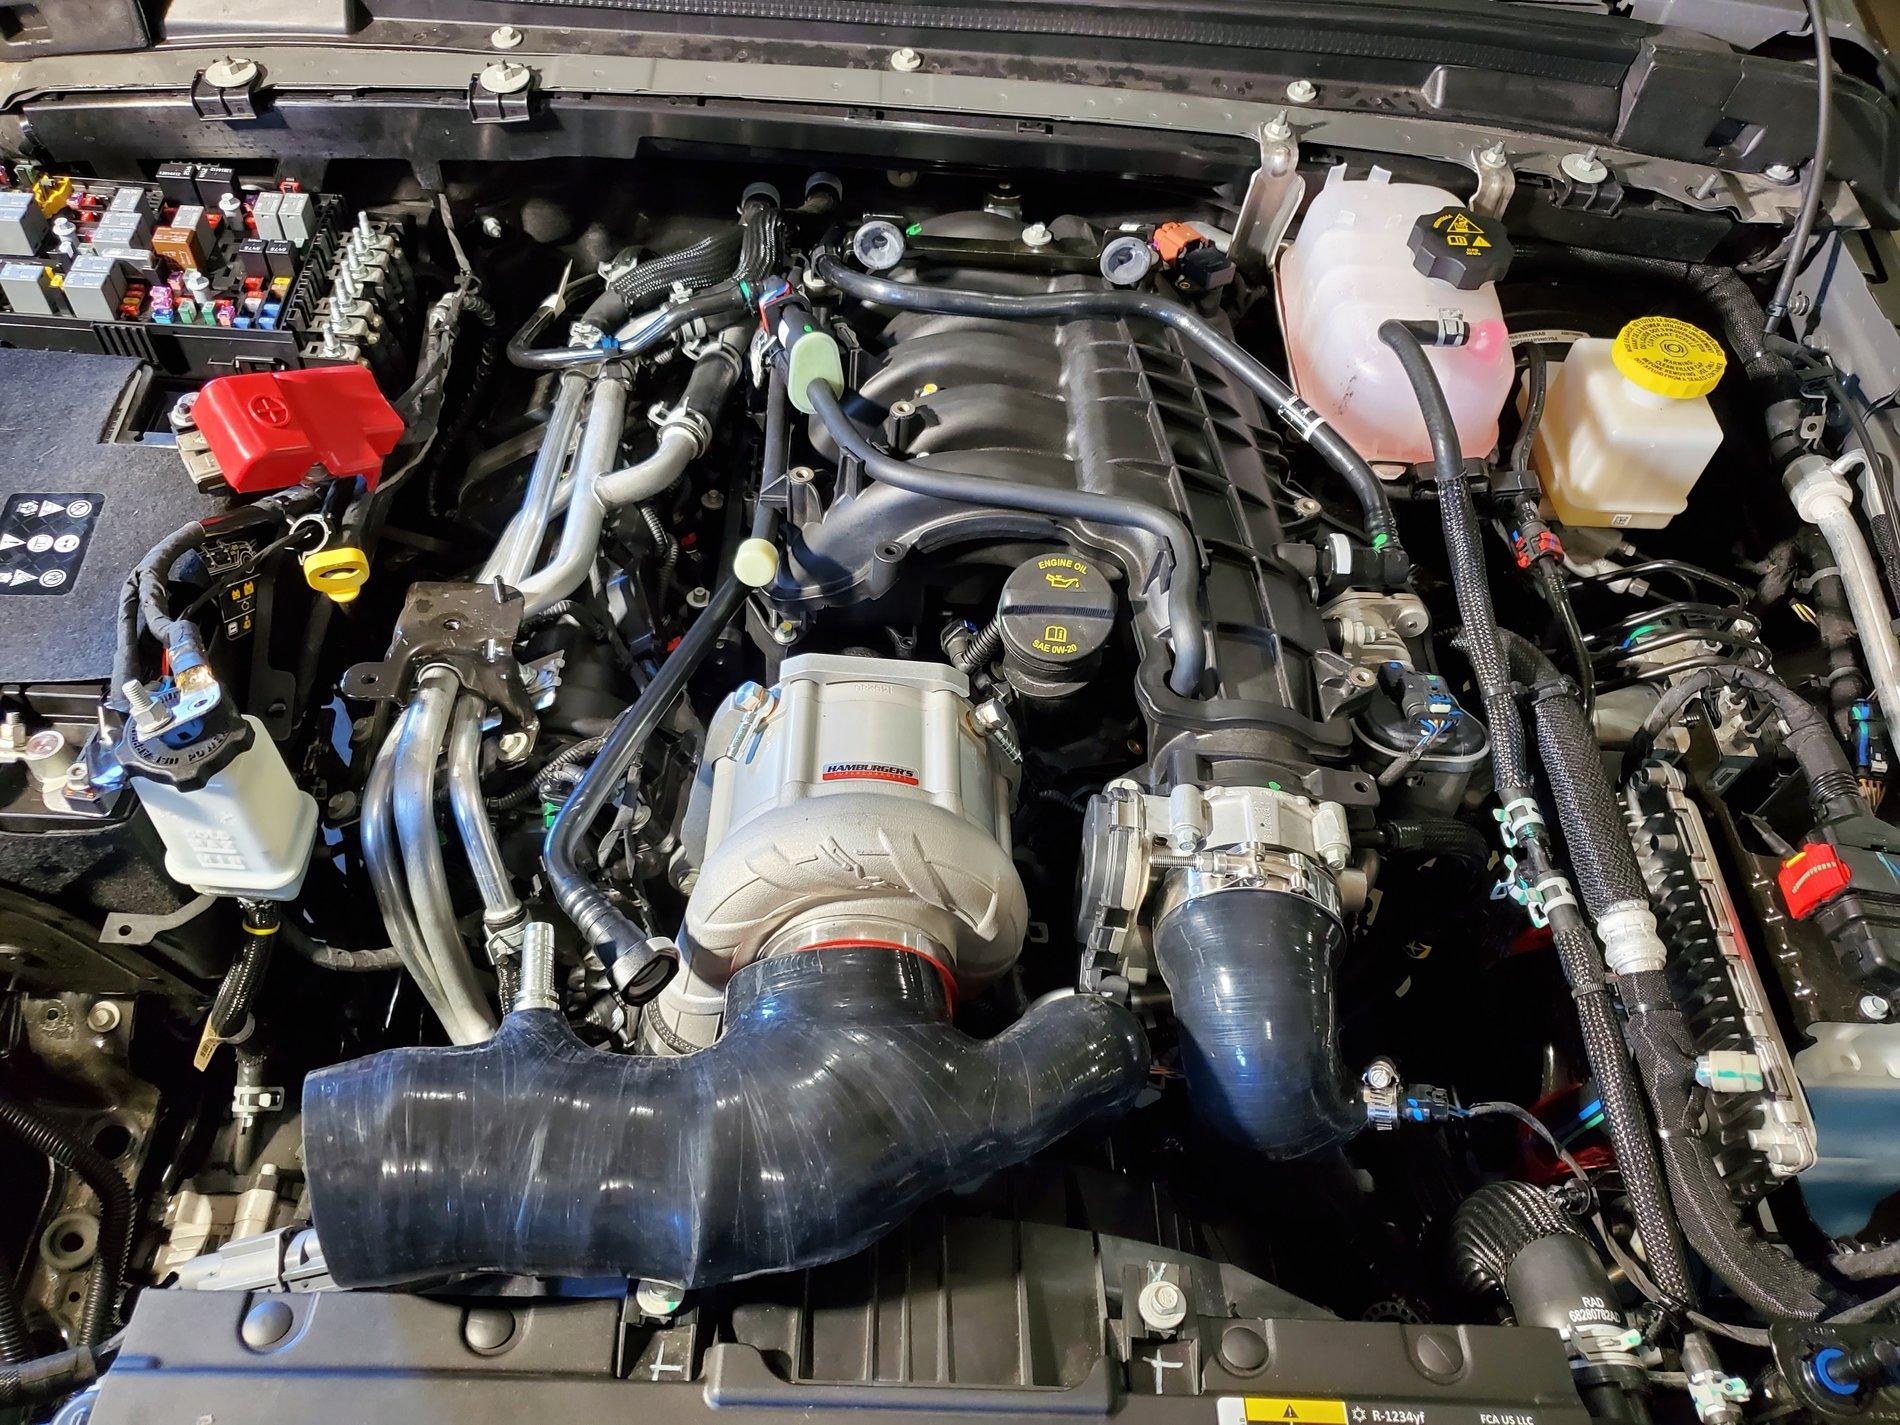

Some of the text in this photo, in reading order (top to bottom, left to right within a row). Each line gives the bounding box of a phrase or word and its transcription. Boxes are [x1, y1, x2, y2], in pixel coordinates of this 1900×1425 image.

[1038, 558, 1088, 575] ENGINE OIL
[1032, 639, 1078, 654] SAE 0W-20
[827, 764, 914, 777] HAMBURGER'S
[1581, 1296, 1605, 1309] RAD
[1372, 1409, 1425, 1425] R-1234yf
[1480, 1413, 1534, 1425] FCA US LLC
